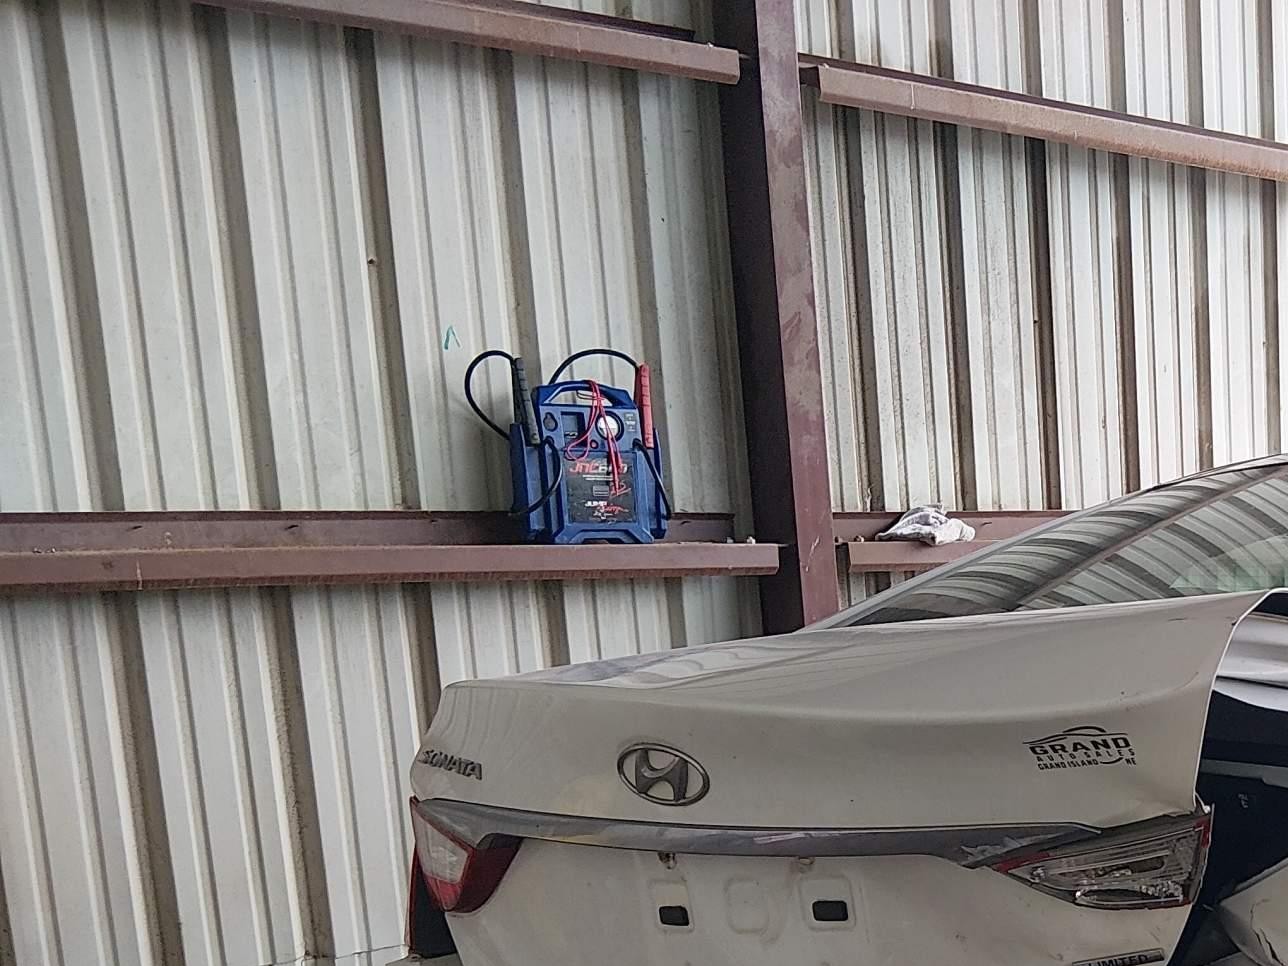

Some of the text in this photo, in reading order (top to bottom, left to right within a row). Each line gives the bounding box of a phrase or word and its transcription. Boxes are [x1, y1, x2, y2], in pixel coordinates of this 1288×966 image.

[1029, 737, 1131, 755] GRAND
[1036, 748, 1135, 762] AUTO SALES
[419, 749, 482, 781] SONATA
[1037, 760, 1067, 770] GRAND
[1067, 758, 1099, 769] ISLAND
